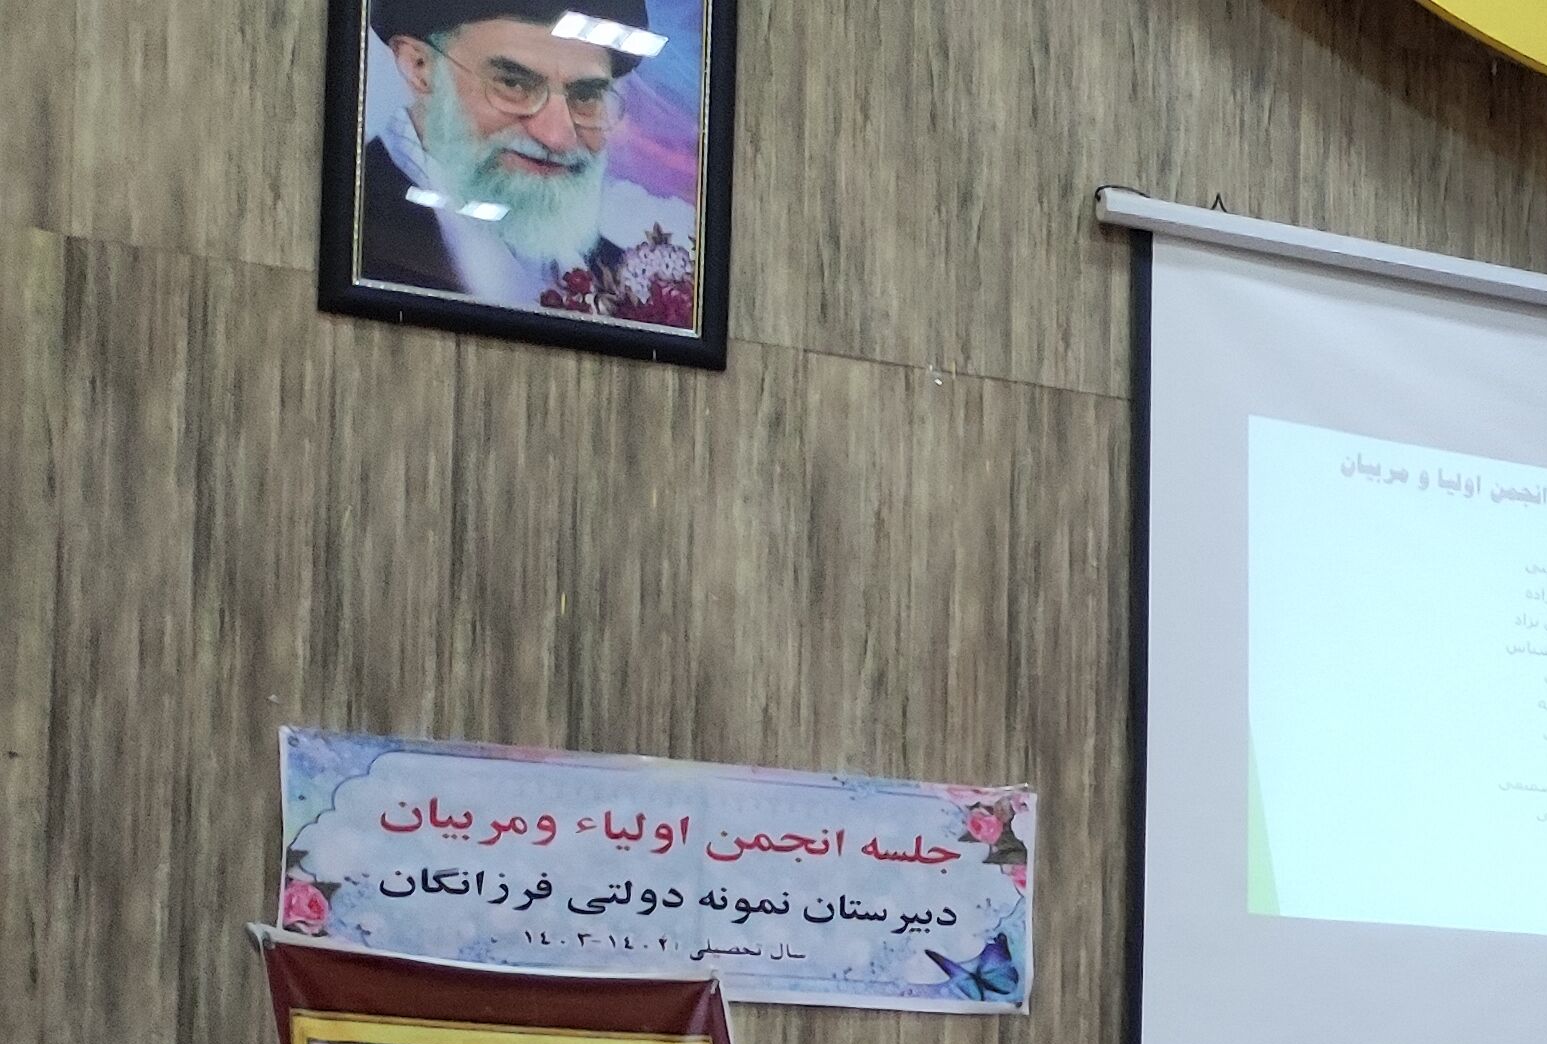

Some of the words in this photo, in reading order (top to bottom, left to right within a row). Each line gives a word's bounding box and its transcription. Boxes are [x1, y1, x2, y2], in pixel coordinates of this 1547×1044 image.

[1340, 452, 1410, 484] مربیان
[1418, 469, 1430, 491] و
[1438, 467, 1482, 500] اولیا
[1490, 481, 1547, 508] انجمن
[575, 814, 690, 855] اولیاء
[706, 820, 844, 862] انجمن
[860, 834, 962, 875] جلسه
[380, 866, 553, 911] فرزانگان
[568, 879, 684, 917] دولتی
[698, 886, 790, 922] نمونه
[803, 889, 957, 936] دبیرستان
[690, 938, 762, 961] تحصیلی
[770, 943, 806, 960] سال
